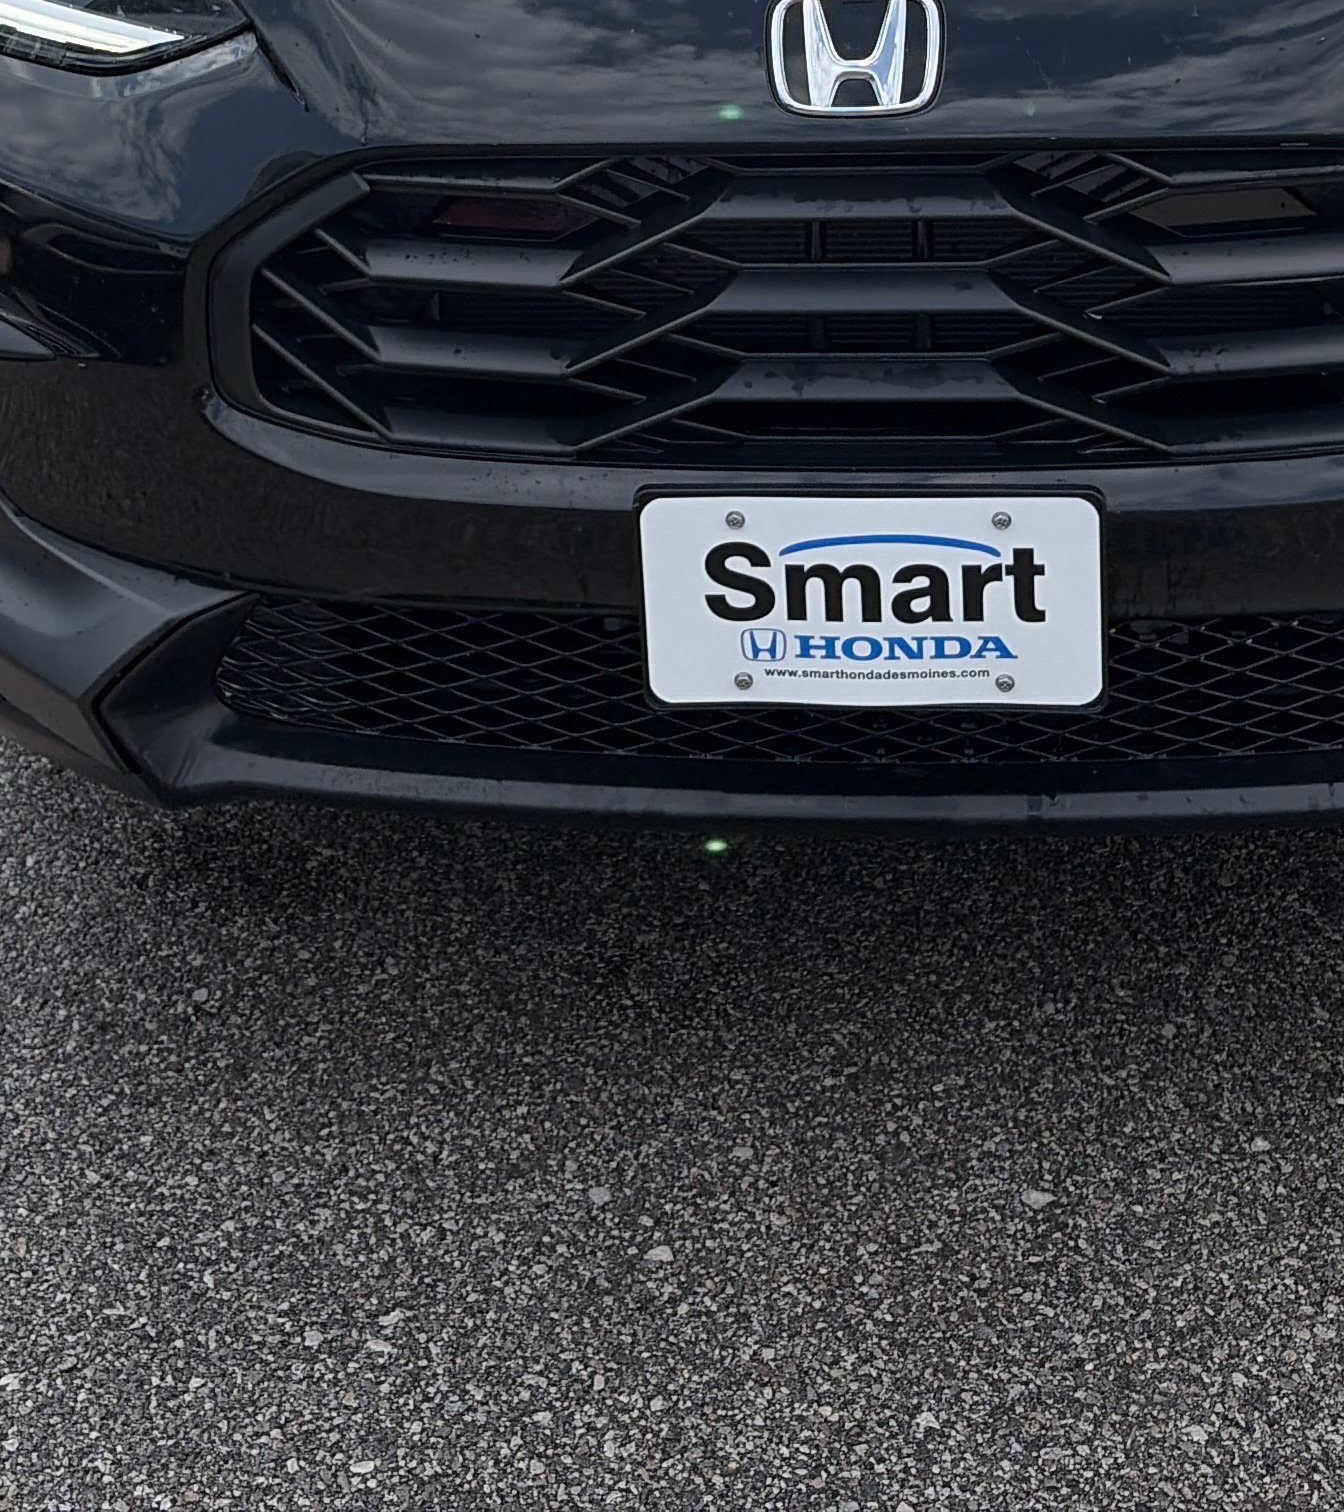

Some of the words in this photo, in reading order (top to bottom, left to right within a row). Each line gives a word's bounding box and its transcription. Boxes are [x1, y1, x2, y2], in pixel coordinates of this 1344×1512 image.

[705, 541, 1046, 623] Smart
[794, 634, 1018, 661] HONDA
[765, 667, 990, 681] www.smarthondadesmoines.com
